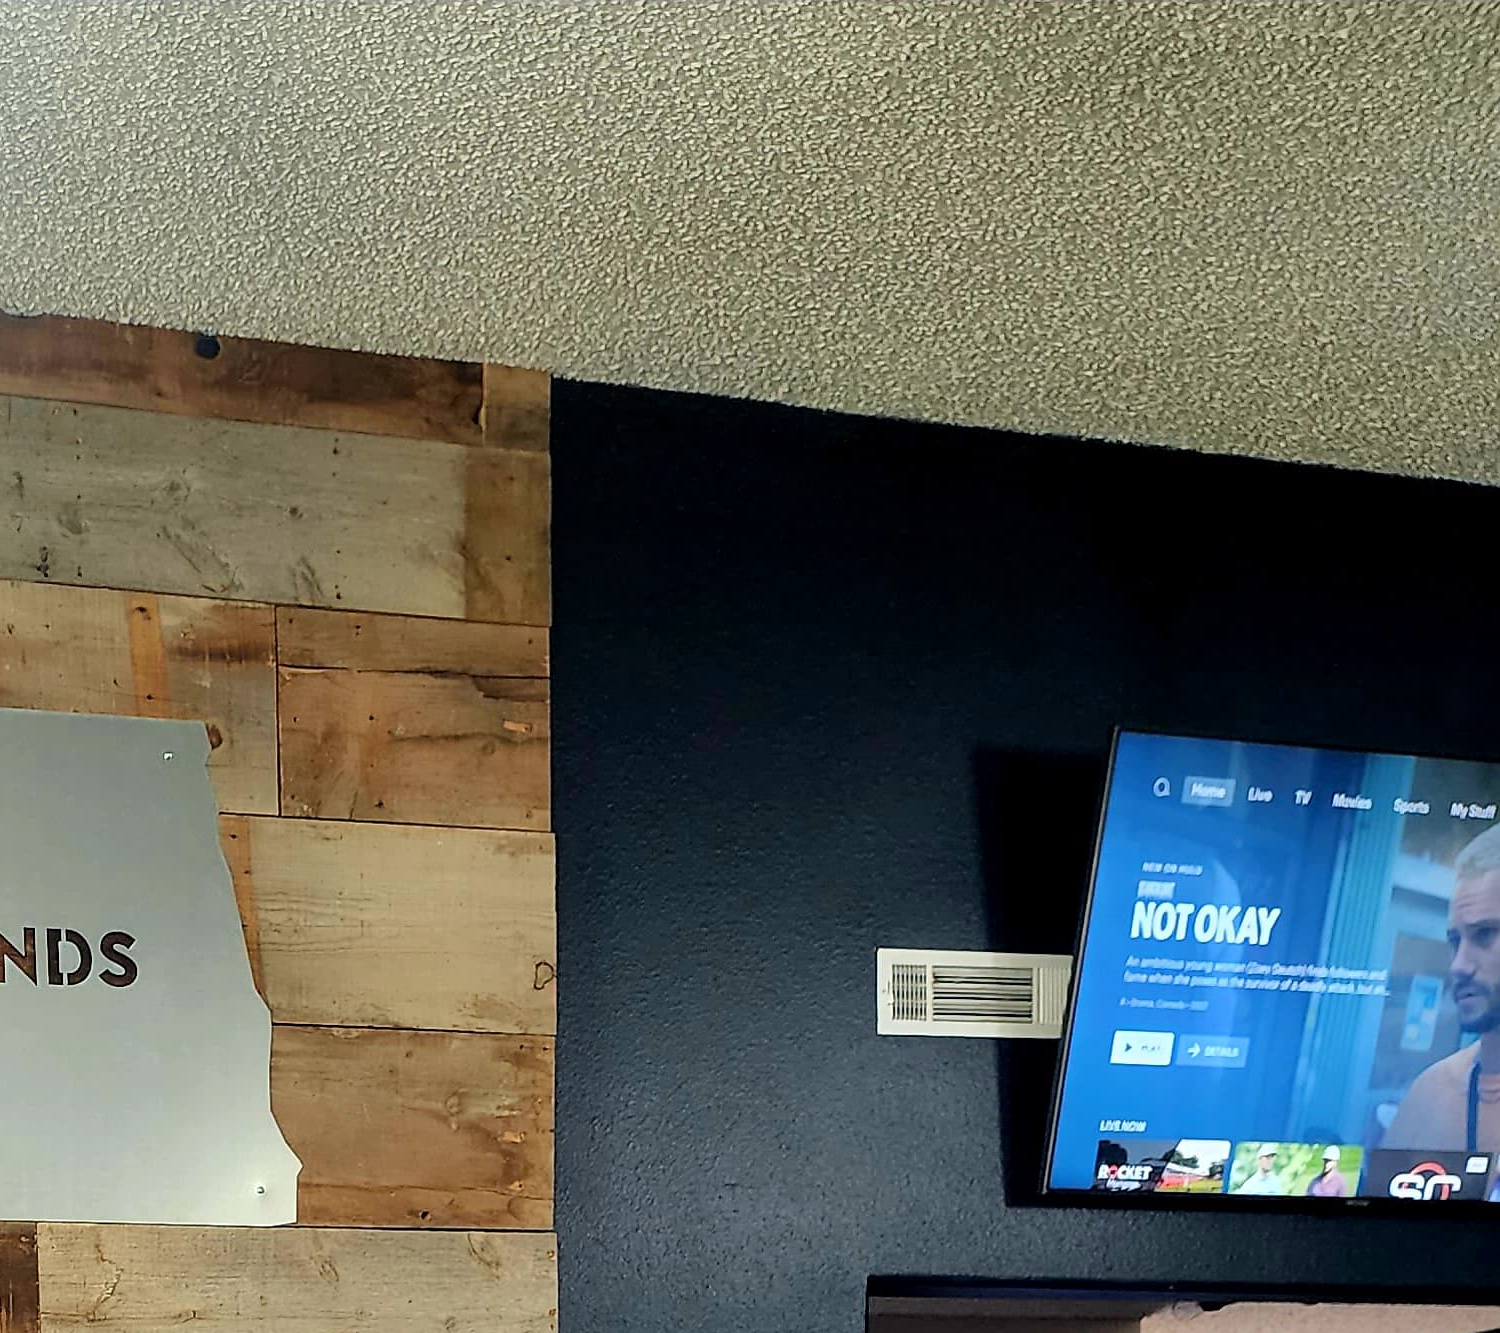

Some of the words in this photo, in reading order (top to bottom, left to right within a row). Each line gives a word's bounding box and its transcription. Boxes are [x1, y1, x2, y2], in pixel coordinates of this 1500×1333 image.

[1295, 789, 1312, 805] TV
[1130, 901, 1195, 941] NOT
[1193, 904, 1281, 946] OKAY
